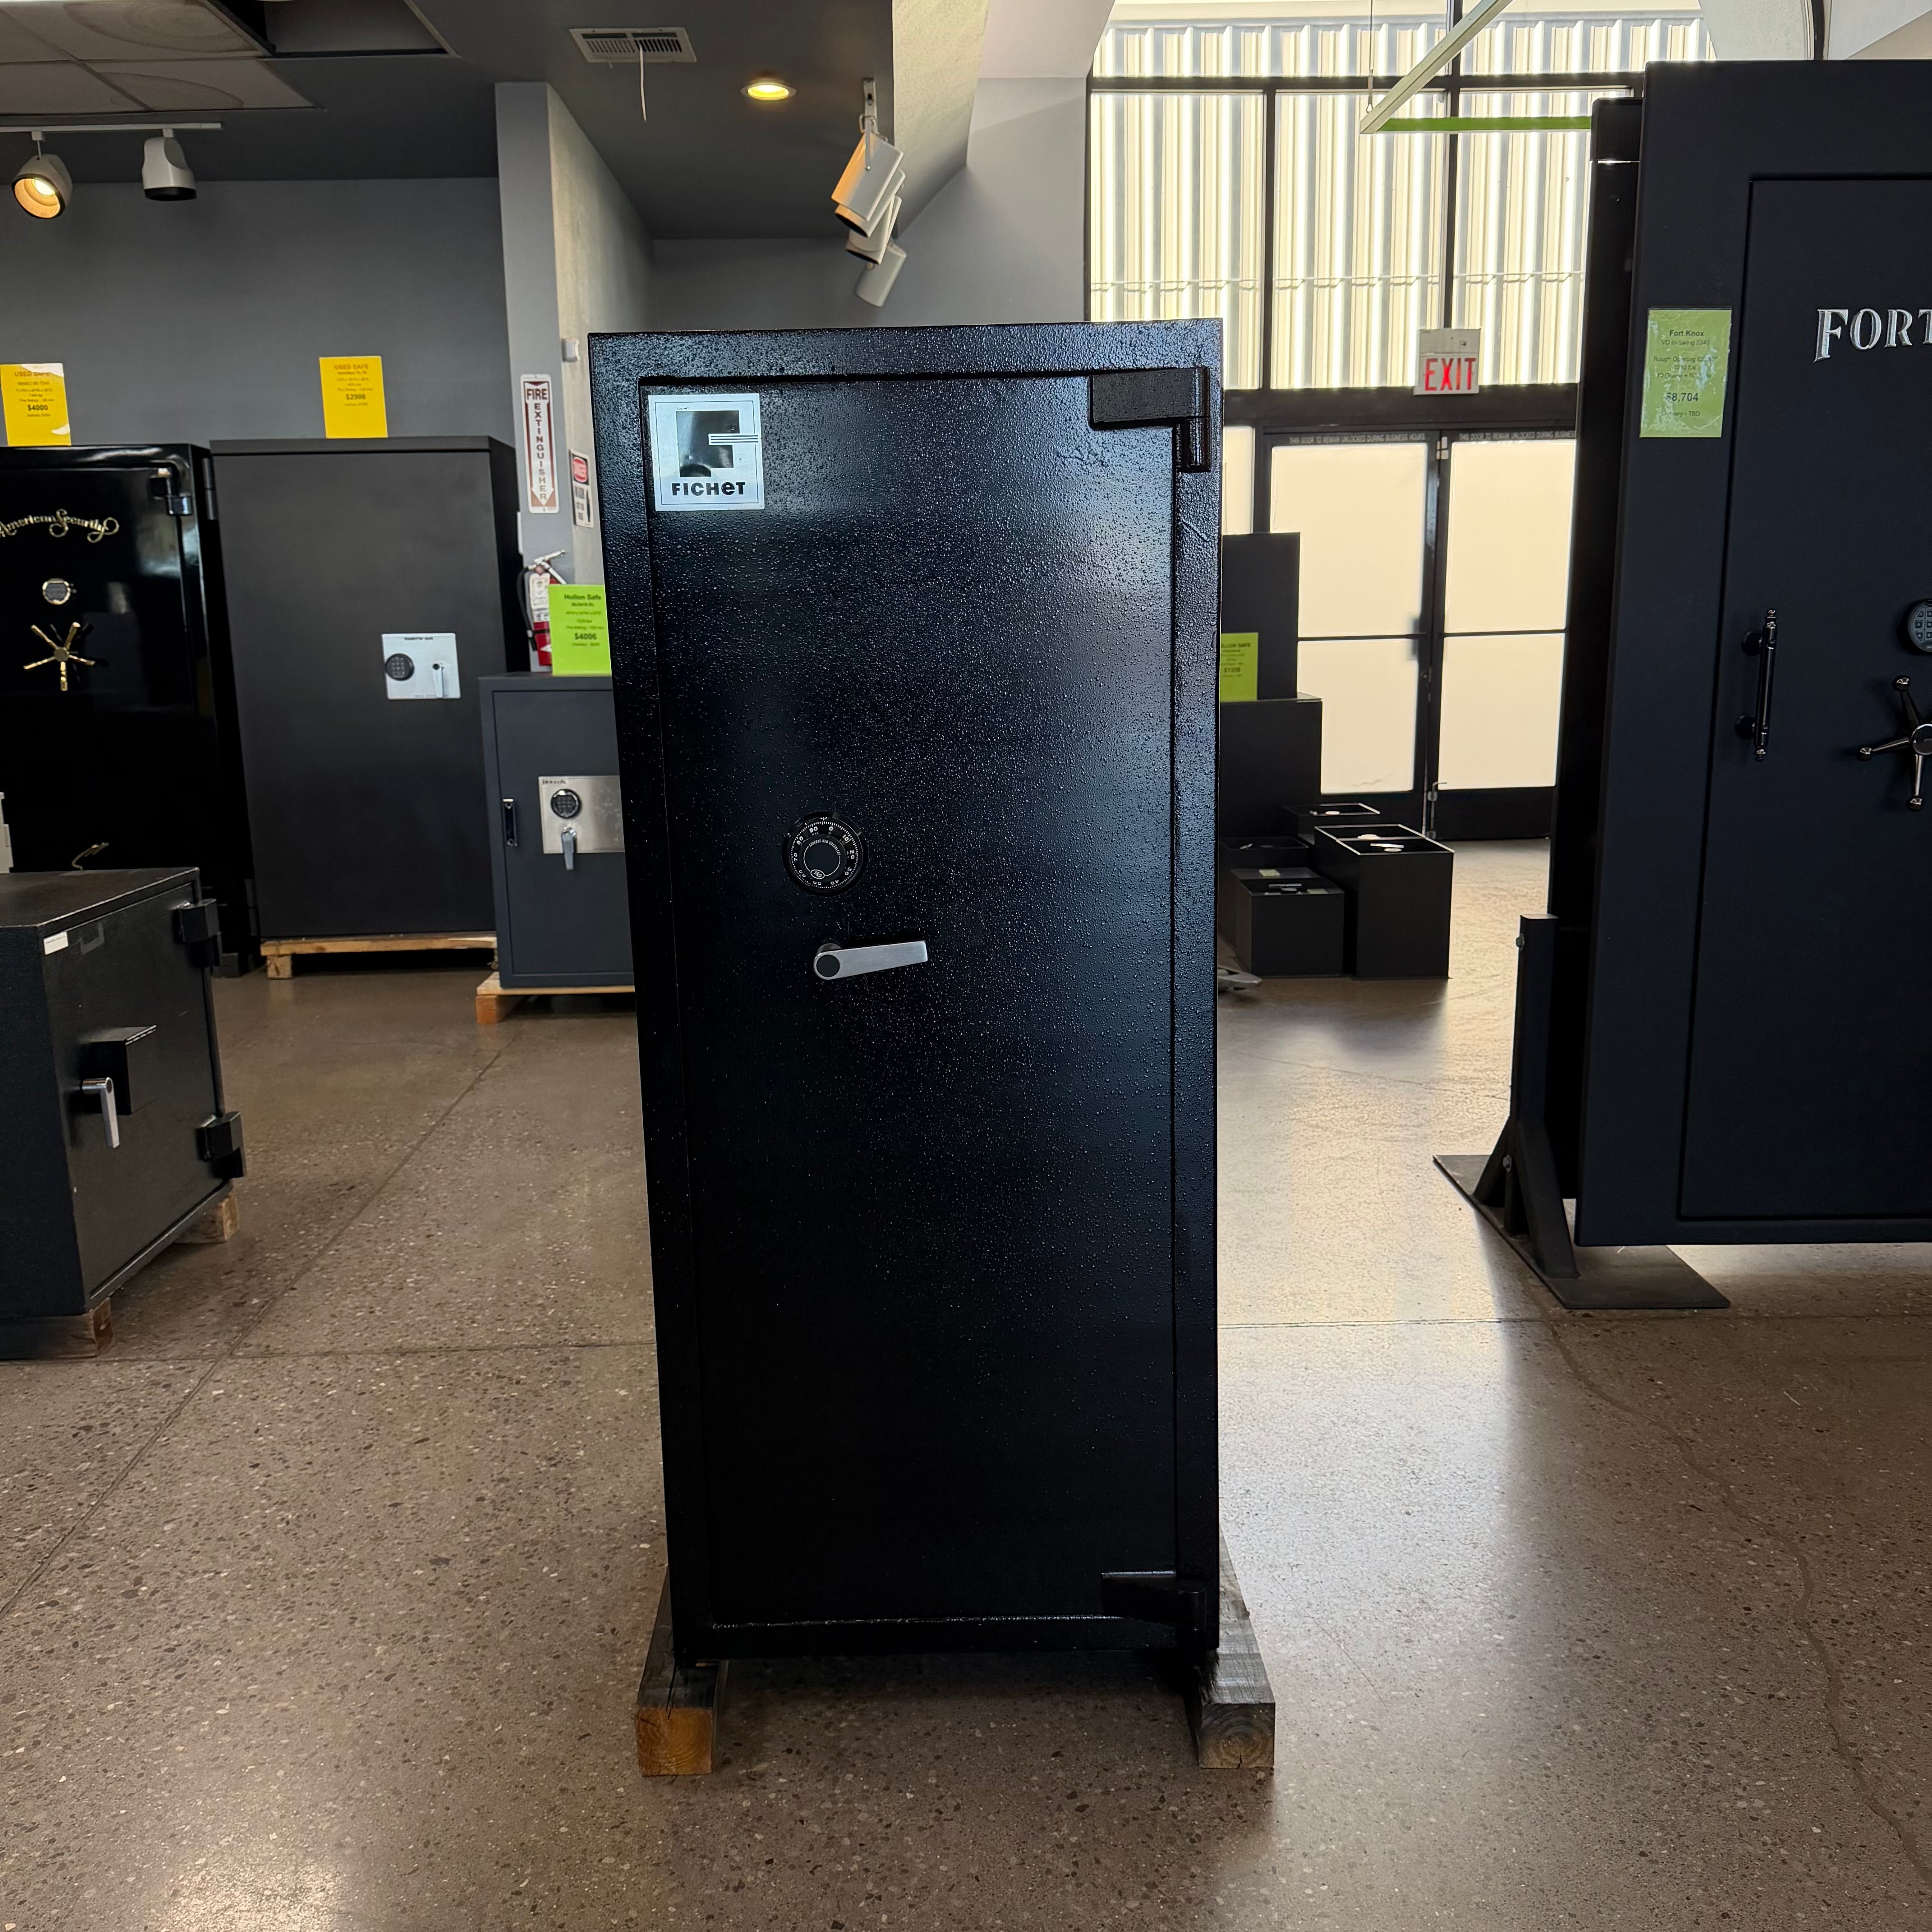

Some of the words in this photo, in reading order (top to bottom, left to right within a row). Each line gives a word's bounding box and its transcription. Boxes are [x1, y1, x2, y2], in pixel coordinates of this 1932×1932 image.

[1425, 358, 1476, 391] EXIT
[526, 388, 548, 400] FIRE
[1665, 392, 1698, 403] $8,704
[534, 403, 547, 501] EXTINGUISHER
[850, 850, 855, 859] 20
